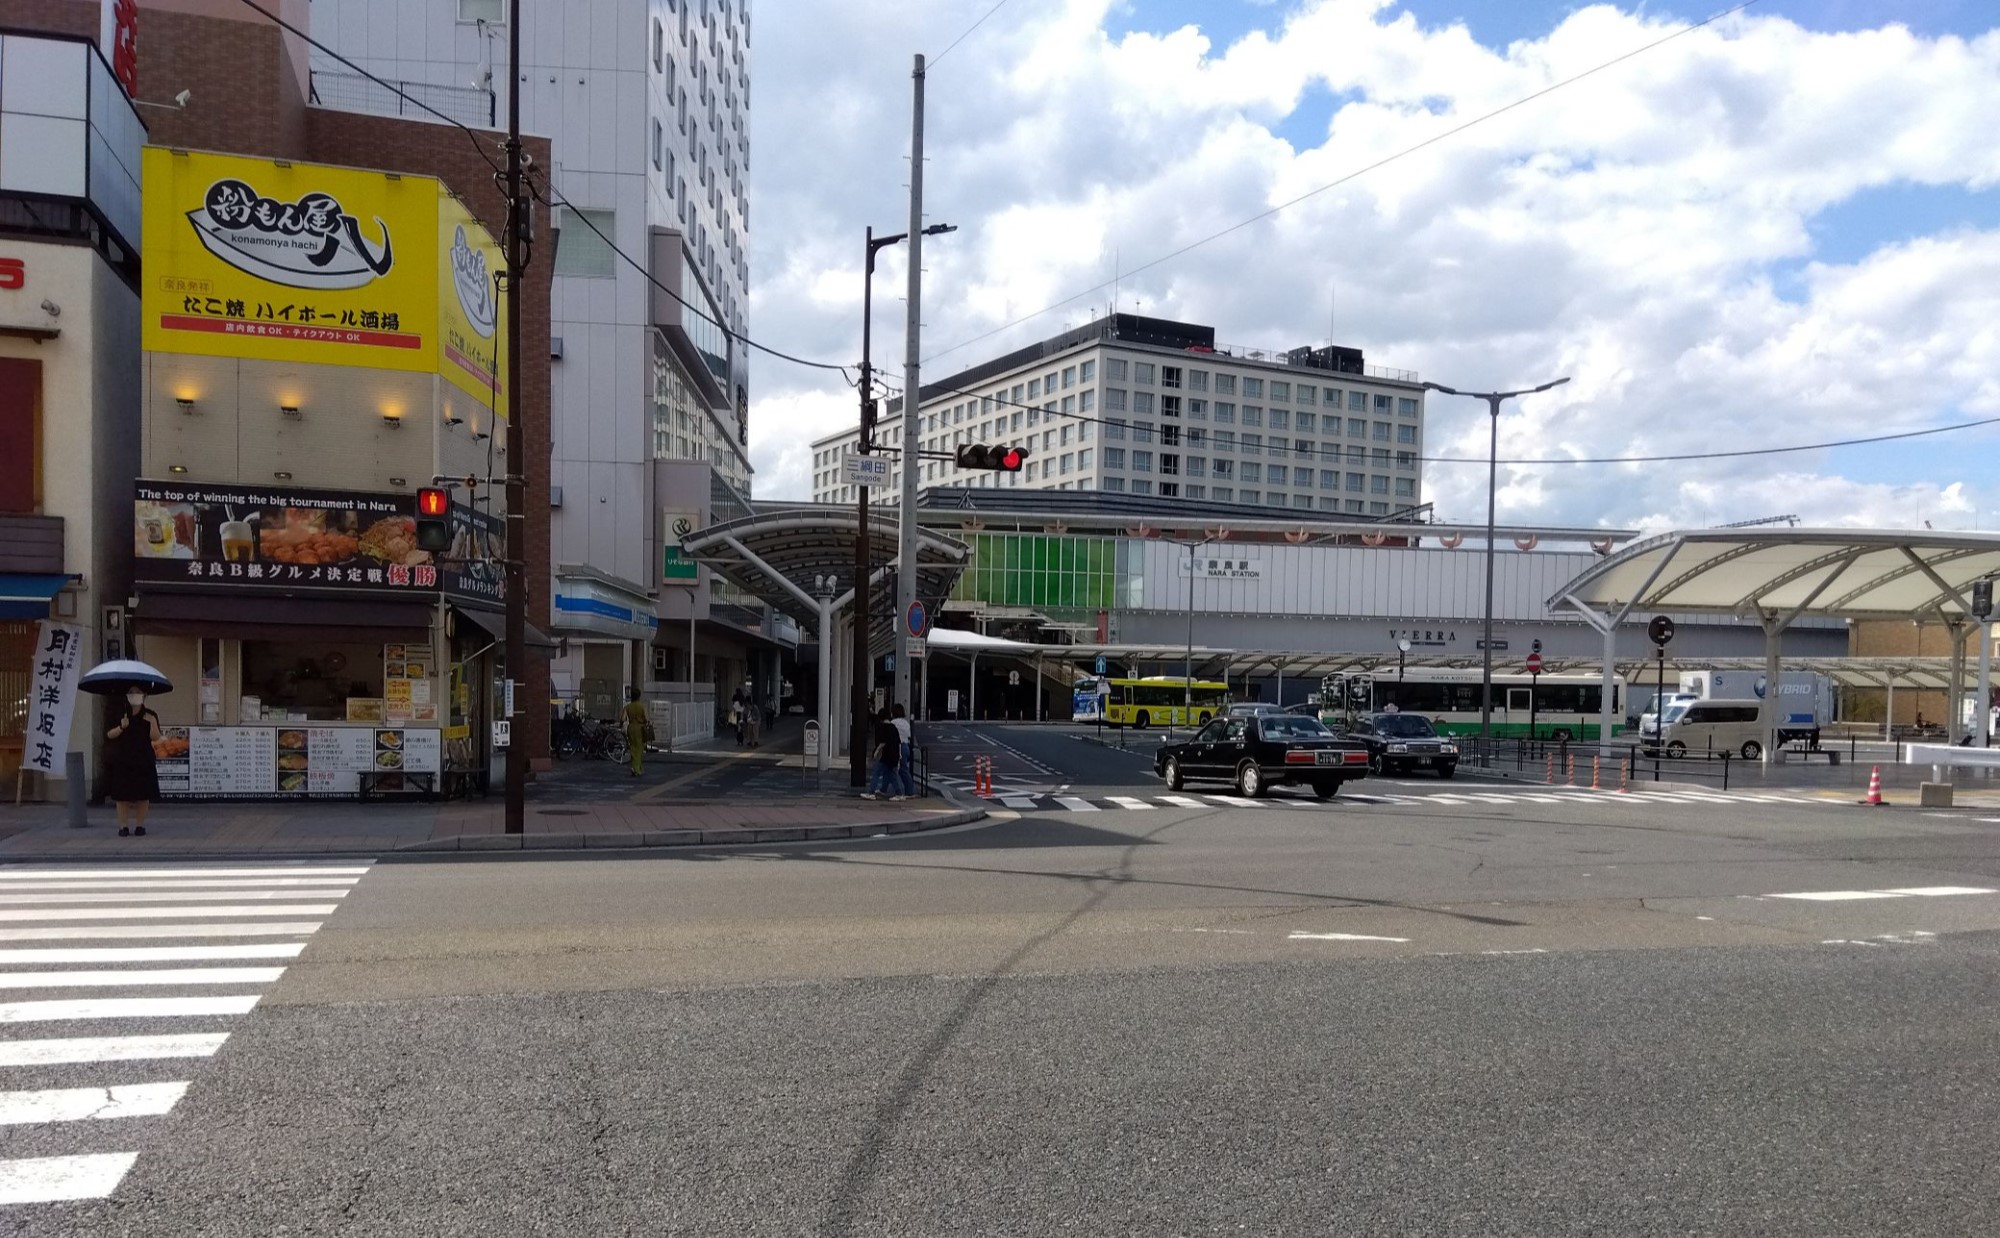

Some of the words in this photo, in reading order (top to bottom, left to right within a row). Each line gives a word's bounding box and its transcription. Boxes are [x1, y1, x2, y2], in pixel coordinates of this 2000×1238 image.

[231, 234, 289, 248] konamonya
[292, 238, 318, 251] hachi
[164, 279, 210, 292] 奈良発祥
[184, 296, 245, 317] たこ焼
[257, 303, 399, 330] ハイボール酒場
[139, 489, 161, 499] The
[164, 490, 184, 501] top
[187, 492, 200, 500] of
[203, 493, 245, 504] winning
[248, 495, 266, 504] the
[270, 496, 287, 506] big
[290, 498, 354, 509] tournament
[357, 500, 367, 510] in
[370, 501, 396, 511] Nara
[1208, 560, 1248, 570] 奈良駅
[33, 629, 70, 769] 月村洋服店
